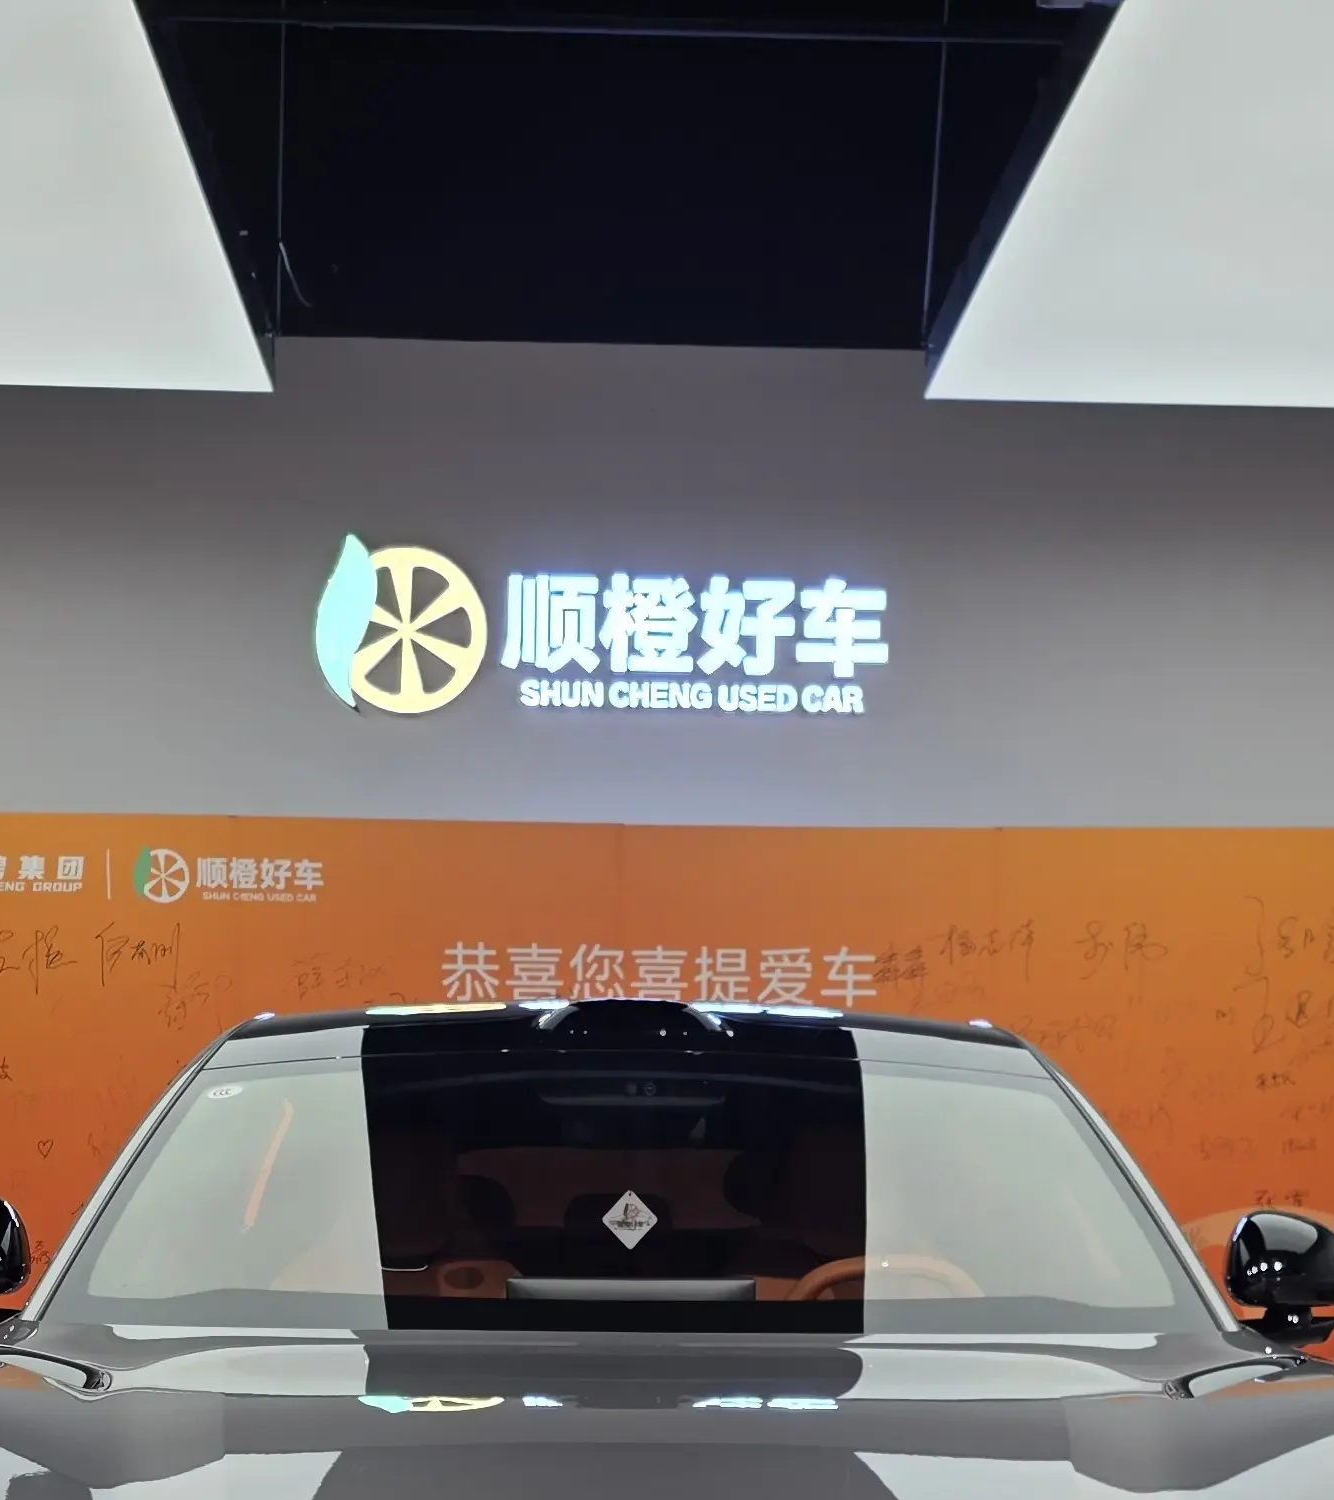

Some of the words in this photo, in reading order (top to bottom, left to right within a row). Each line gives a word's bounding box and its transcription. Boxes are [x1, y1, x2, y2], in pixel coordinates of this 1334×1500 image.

[501, 573, 889, 678] 顺橙好车
[520, 679, 604, 708] SHUN
[609, 681, 713, 710] CHENG
[718, 684, 798, 712] USED
[801, 685, 865, 713] CAR
[33, 882, 83, 892] GROUP
[196, 857, 324, 890] 顺橙好车
[203, 892, 231, 900] SHUN
[268, 893, 294, 902] USED
[296, 894, 317, 902] CAR
[441, 941, 877, 1007] 恭喜您喜提爱车
